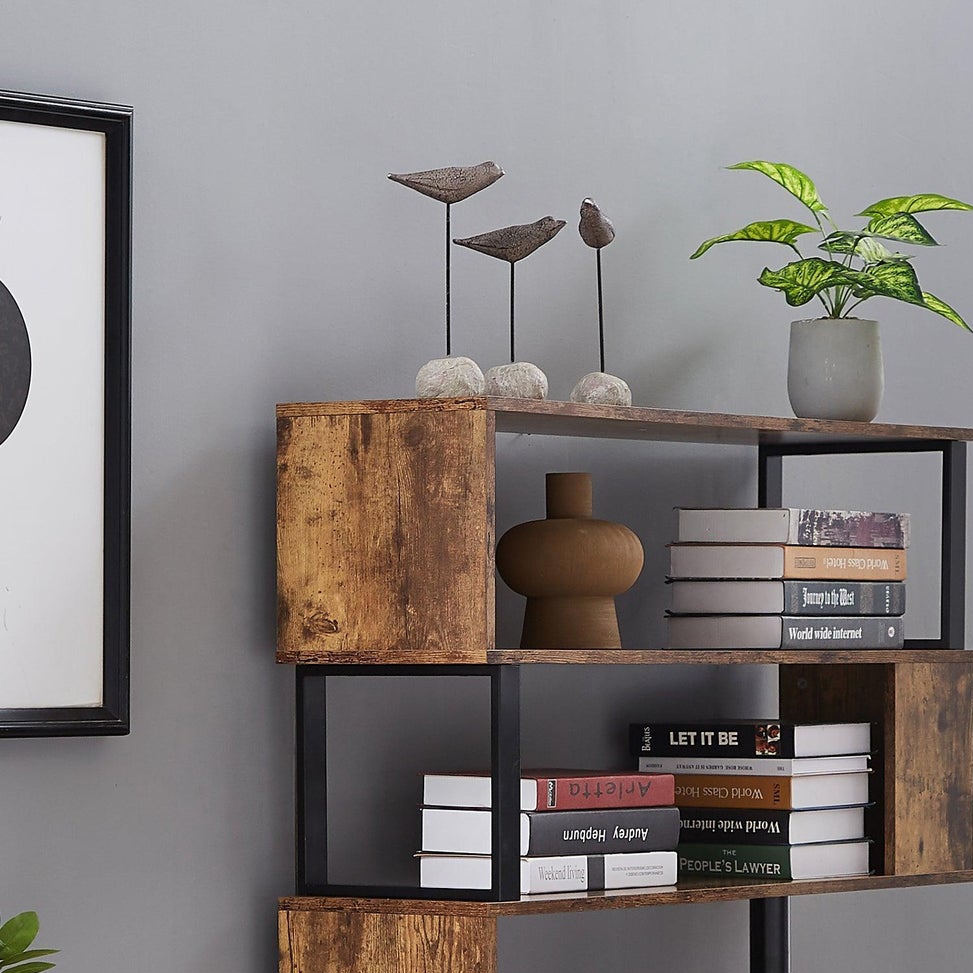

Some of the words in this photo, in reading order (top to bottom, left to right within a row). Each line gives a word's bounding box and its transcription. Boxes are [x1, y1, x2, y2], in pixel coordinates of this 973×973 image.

[848, 558, 866, 569] Class
[866, 559, 889, 570] World
[802, 587, 824, 609] Journey
[824, 590, 830, 605] to
[831, 589, 839, 608] the
[839, 588, 855, 606] West
[788, 627, 813, 640] World
[814, 627, 832, 639] wide
[833, 627, 862, 639] internet
[669, 731, 697, 746] LET
[700, 731, 715, 746] IT
[718, 731, 739, 746] BE
[569, 780, 652, 800] Arletta
[675, 786, 700, 798] Hote
[703, 786, 729, 799] Class
[731, 788, 763, 800] World
[680, 819, 716, 833] interne
[718, 820, 743, 833] wide
[746, 820, 781, 834] World
[563, 826, 606, 843] Hepburn
[613, 825, 649, 842] Audrey
[680, 857, 732, 873] PEOPLE'S
[734, 859, 781, 875] LAWYER
[538, 865, 566, 881] Weekend
[567, 864, 585, 883] living
